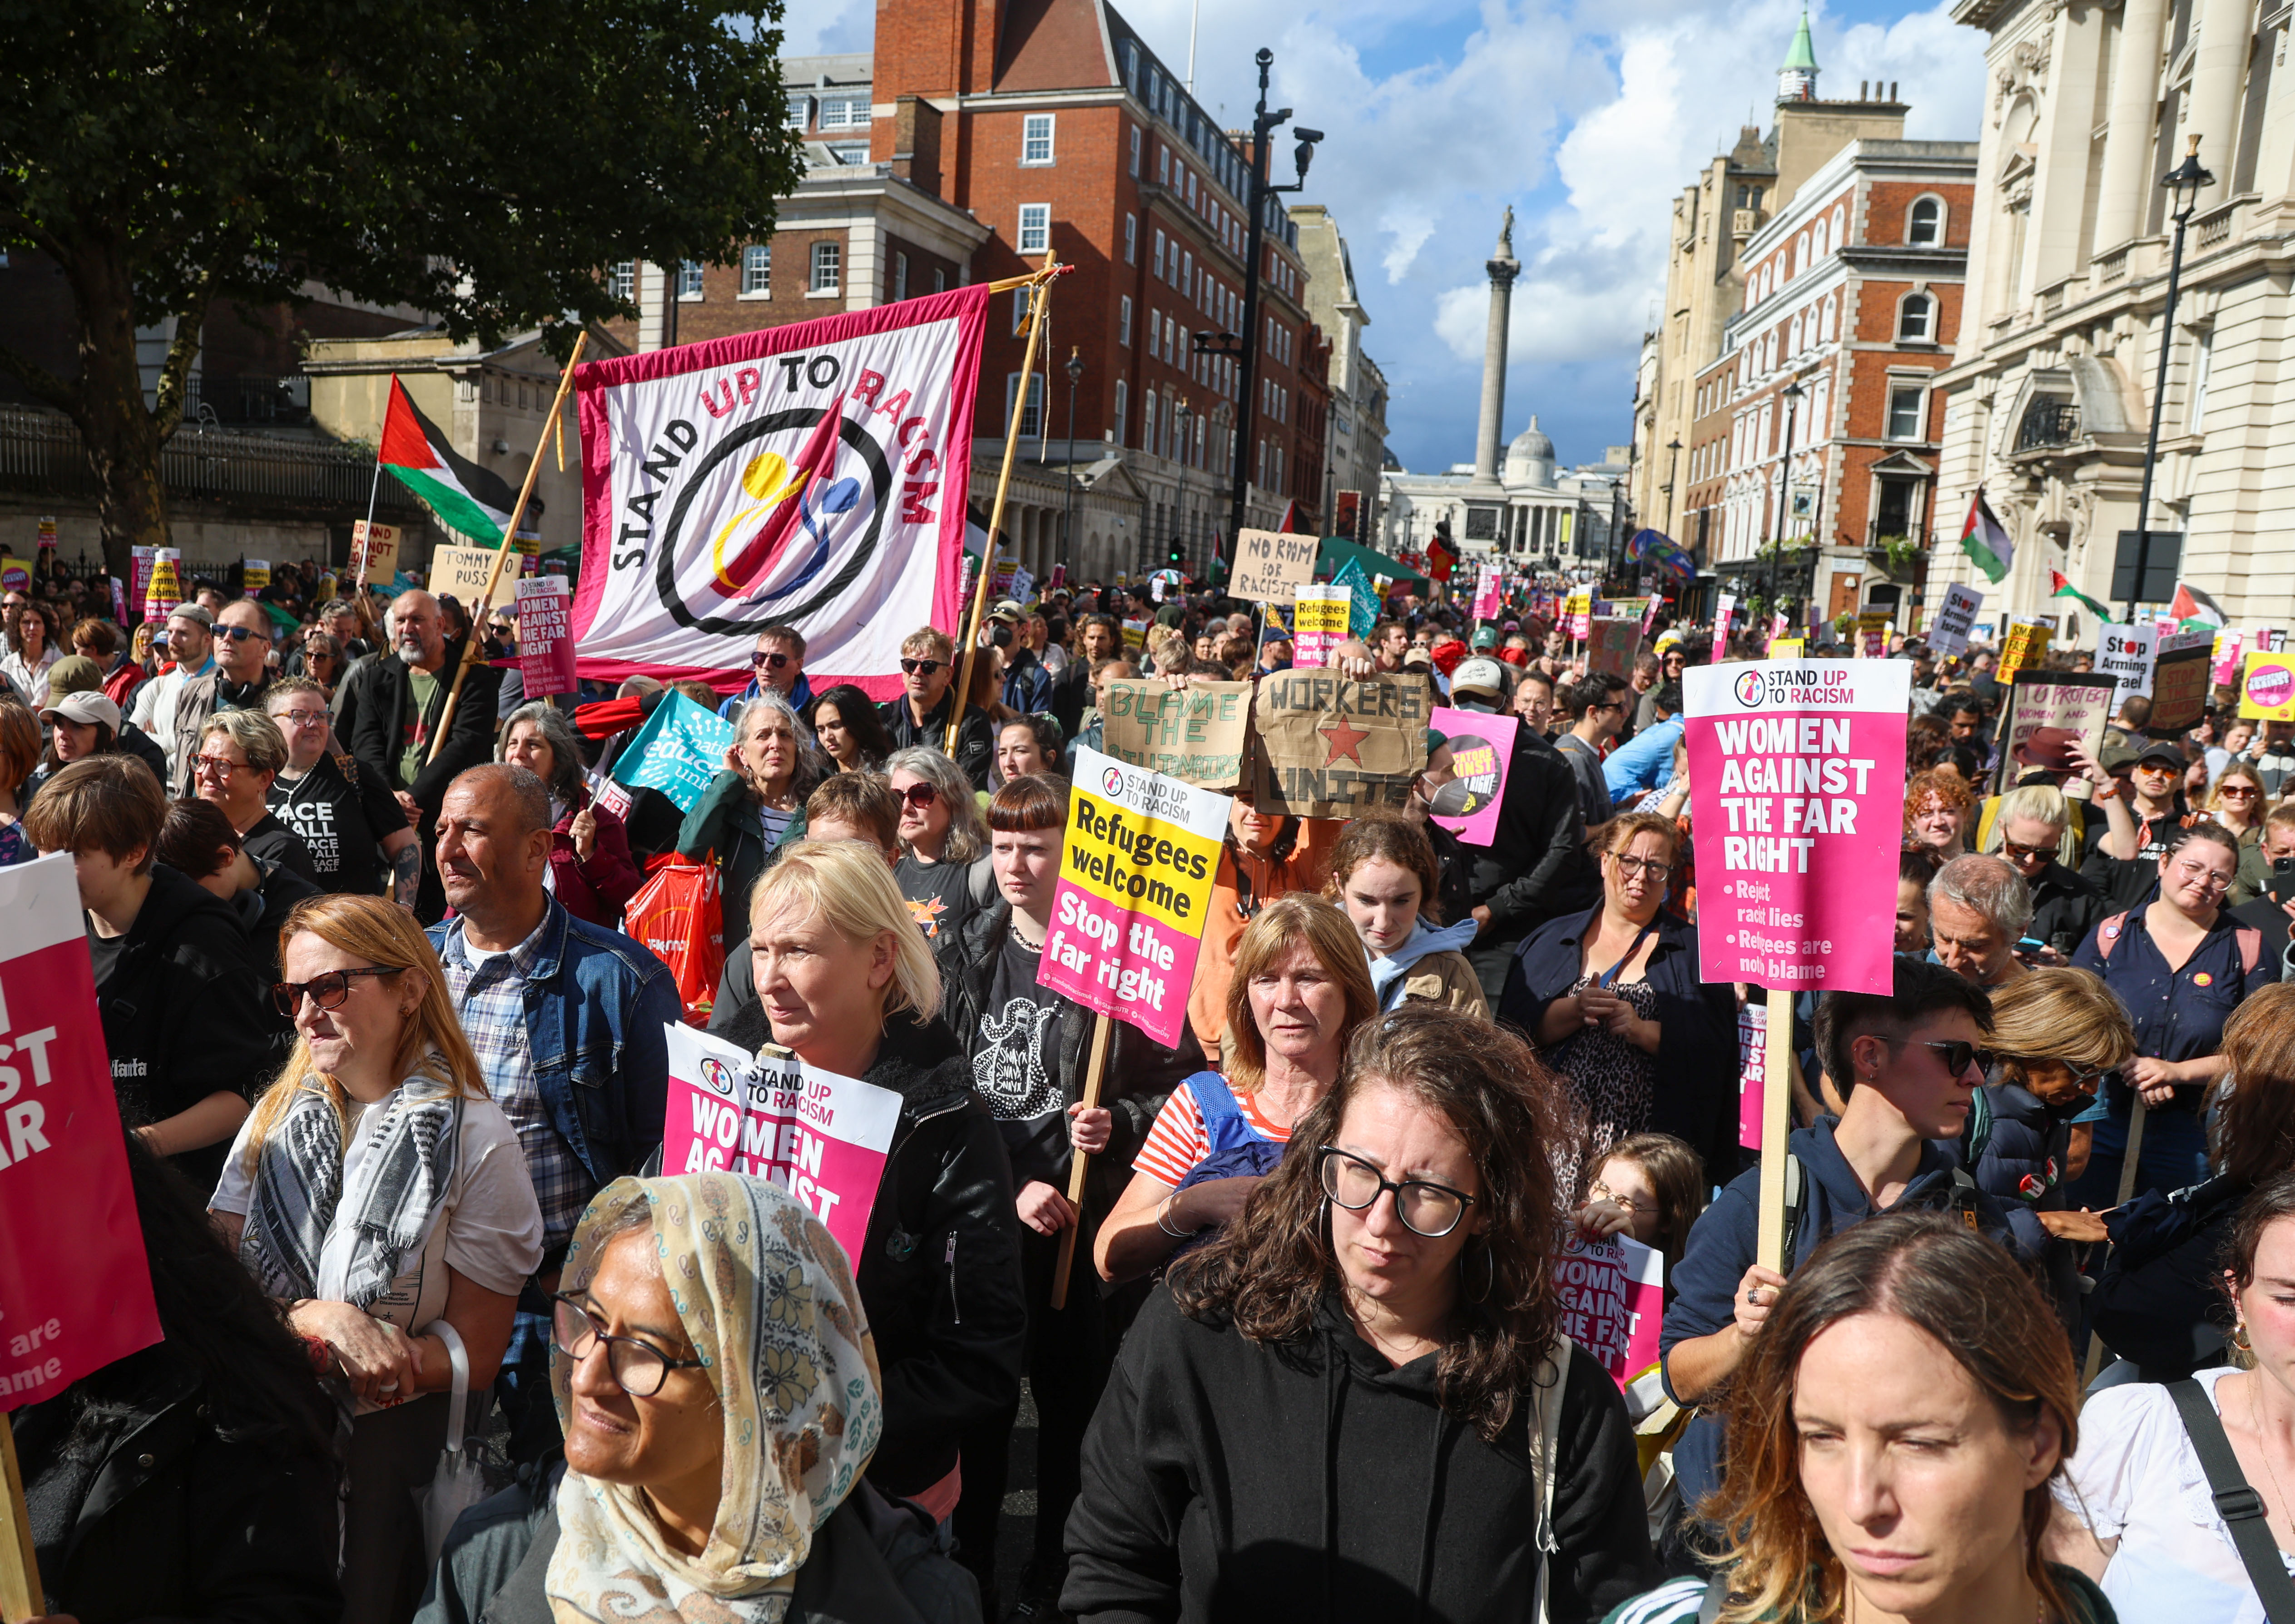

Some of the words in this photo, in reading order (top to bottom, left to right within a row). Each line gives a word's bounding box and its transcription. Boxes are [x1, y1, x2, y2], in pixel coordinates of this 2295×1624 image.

[614, 419, 698, 570] STAND
[700, 367, 759, 419] UP
[779, 355, 840, 392] TO
[367, 541, 394, 556] NOT
[1248, 538, 1271, 558] NO
[1278, 539, 1314, 565] ROOM
[444, 550, 492, 569] TOMMY
[1262, 563, 1282, 576] FOR
[1239, 574, 1298, 597] RACISTS
[521, 597, 560, 613] OMEN
[1299, 603, 1347, 615] Refugees
[1949, 593, 1975, 614] Stop
[522, 610, 567, 628] GAINST
[1299, 617, 1343, 628] welcome
[1940, 619, 1968, 637] Israel
[1943, 607, 1973, 628] Arming
[522, 627, 539, 642] HE
[540, 625, 566, 639] FAR
[1297, 634, 1319, 648] Stop
[1321, 634, 1340, 646] the
[1296, 648, 1312, 660] far
[2107, 636, 2147, 657] Stop
[2102, 657, 2147, 674] Arming
[1768, 670, 1818, 686] STAND
[1823, 670, 1848, 686] UP
[2166, 668, 2196, 685] STOP
[2248, 677, 2289, 691] AGAINST
[1110, 684, 1239, 721] BLAME
[1271, 677, 1422, 719] WORKERS
[1769, 688, 1786, 704] TO
[1790, 687, 1854, 704] RACISM
[2019, 684, 2049, 704] TO
[2052, 685, 2112, 708] PROTECT
[2167, 686, 2191, 701] THE
[2017, 707, 2057, 719] WOMEN
[2064, 709, 2088, 719] AND
[1138, 718, 1209, 746] THE
[1714, 717, 1851, 756] WOMEN
[1267, 766, 1414, 806] UNITE
[1469, 773, 1496, 794] RIGHT
[1720, 758, 1875, 795] AGAINST
[1127, 774, 1167, 798] STAND
[1170, 785, 1188, 802] UP
[1125, 789, 1139, 806] TO
[1141, 797, 1190, 824] RACISM
[1720, 797, 1773, 833] THE
[1783, 798, 1858, 835] FAR
[291, 821, 337, 837] ALL
[1076, 797, 1208, 880] Refugees
[315, 849, 340, 858] ALL
[1724, 836, 1815, 874] RIGHT
[1072, 845, 1191, 918] welcome
[1736, 880, 1770, 903] Reject
[1737, 905, 1766, 926] racist
[1769, 907, 1804, 928] lies
[1058, 891, 1119, 951] Stop
[1128, 921, 1175, 971] the
[1802, 940, 1832, 955] are
[1050, 931, 1091, 975] far
[1096, 957, 1166, 1012] right
[1740, 956, 1760, 974] not
[1768, 958, 1825, 979] blame
[1098, 1000, 1129, 1015] @StandUTR
[1755, 1010, 1765, 1018] UP
[748, 1065, 804, 1091] STAND
[808, 1080, 832, 1103] UP
[747, 1083, 768, 1104] TO
[773, 1092, 834, 1127] RACISM
[691, 1092, 824, 1179] WOMEN
[1590, 1245, 1604, 1257] TO
[1559, 1287, 1642, 1336] GAINST
[10, 1317, 61, 1357] are
[1596, 1318, 1630, 1360] FAR
